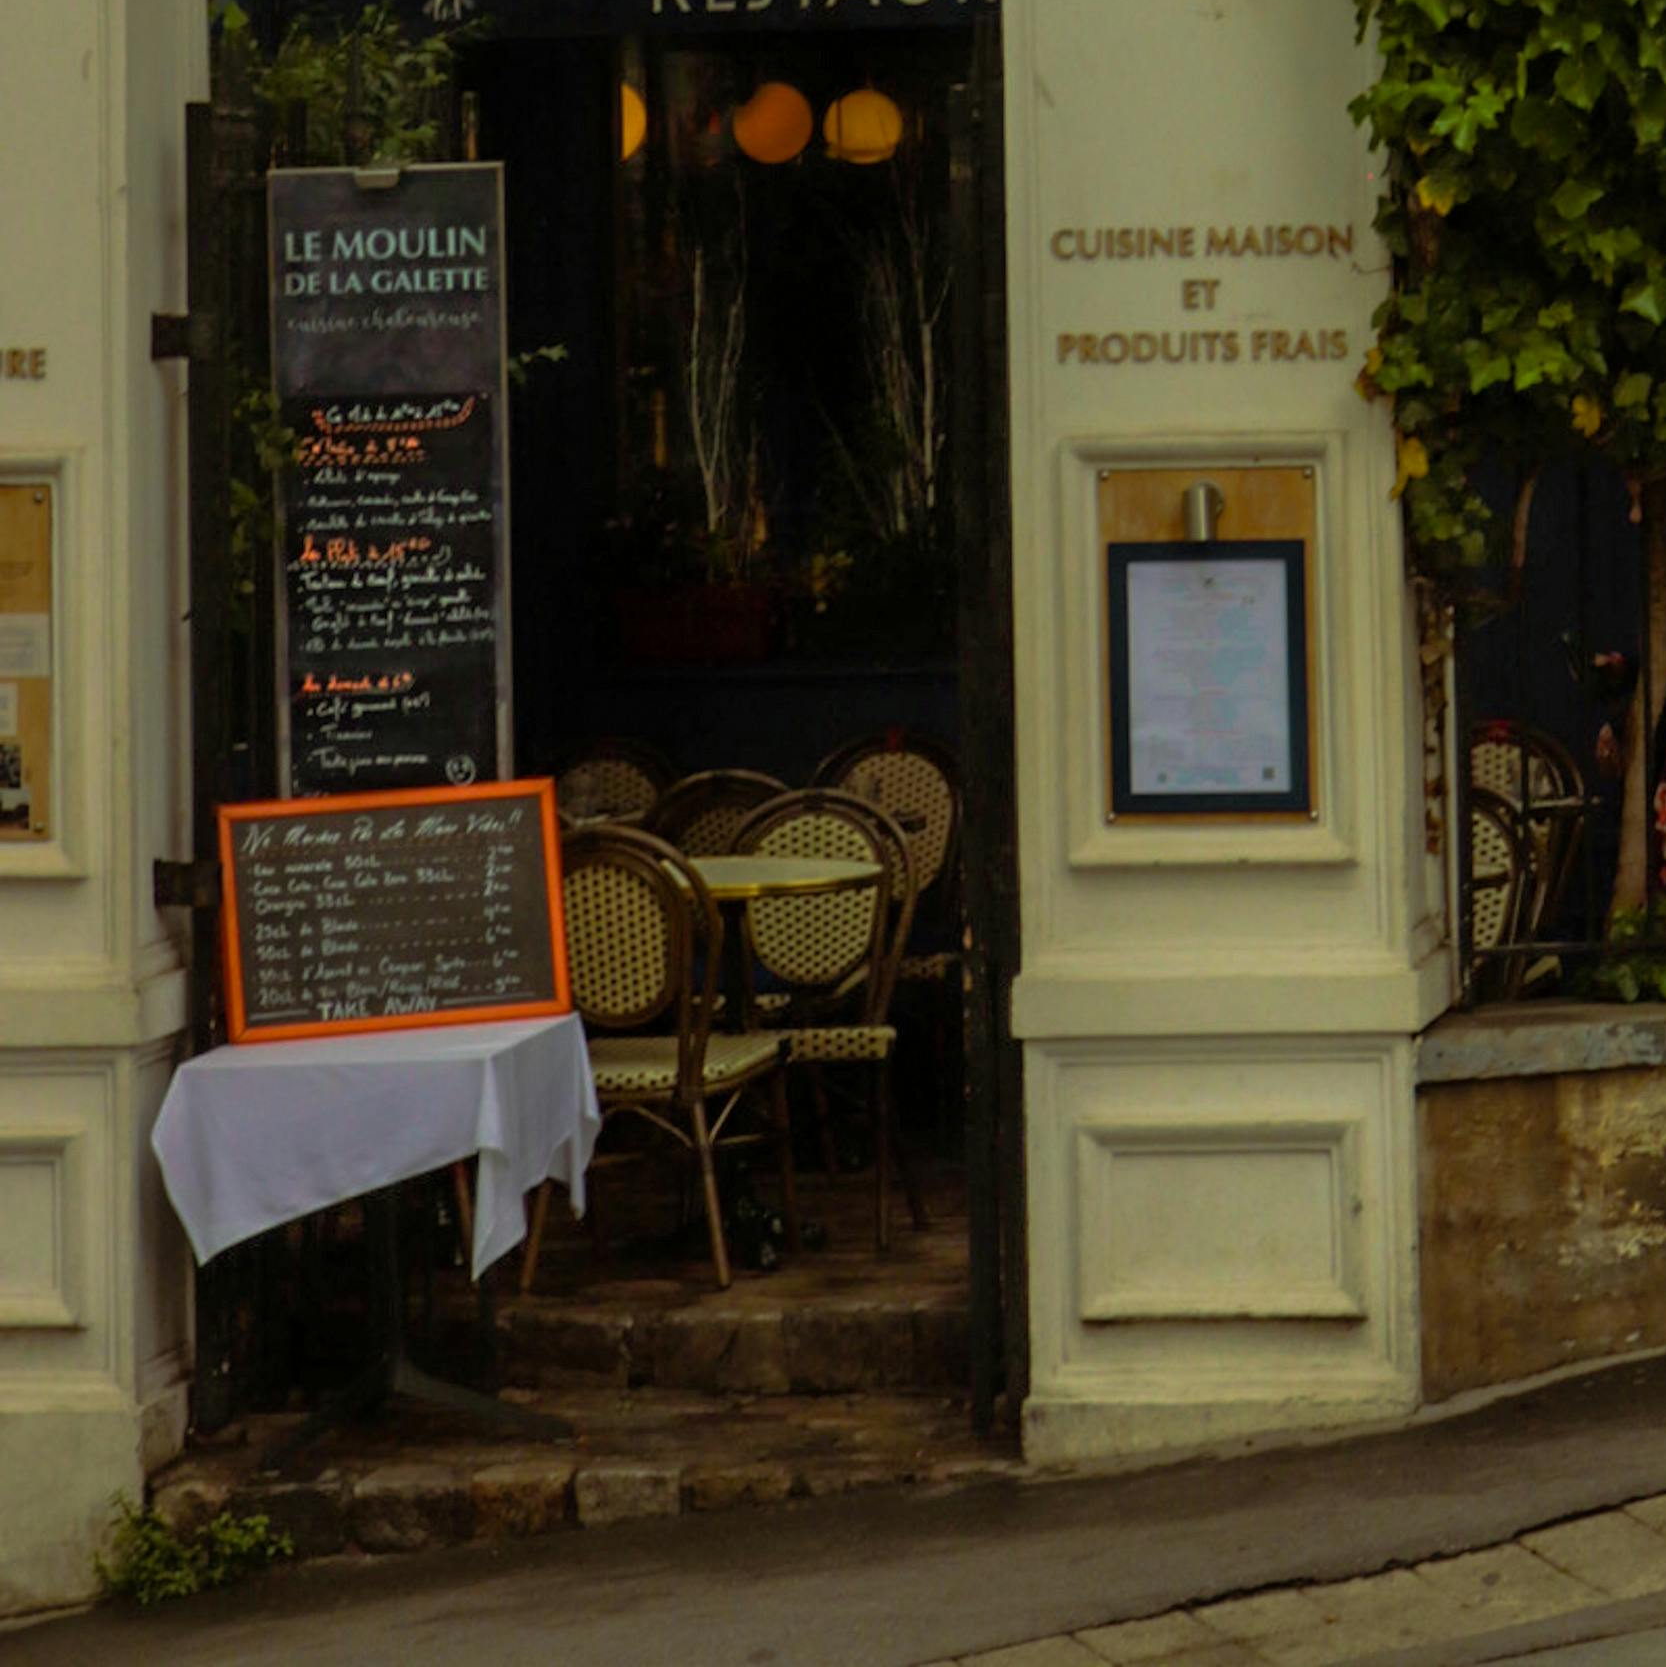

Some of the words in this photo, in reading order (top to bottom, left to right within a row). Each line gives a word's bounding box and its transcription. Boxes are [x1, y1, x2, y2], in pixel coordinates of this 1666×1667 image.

[285, 230, 321, 262] LE
[332, 225, 487, 261] MOULIN
[1050, 227, 1195, 260] CUISINE
[1206, 224, 1354, 259] MAISON
[284, 272, 320, 296] DE
[330, 271, 364, 295] LA
[370, 267, 488, 293] GALETTE
[1183, 278, 1219, 310] ET
[1057, 330, 1240, 365] PRODUITS
[1251, 329, 1349, 361] FRAIS
[0, 348, 47, 379] RE
[316, 999, 370, 1021] TAKE
[384, 995, 438, 1017] AWAY
